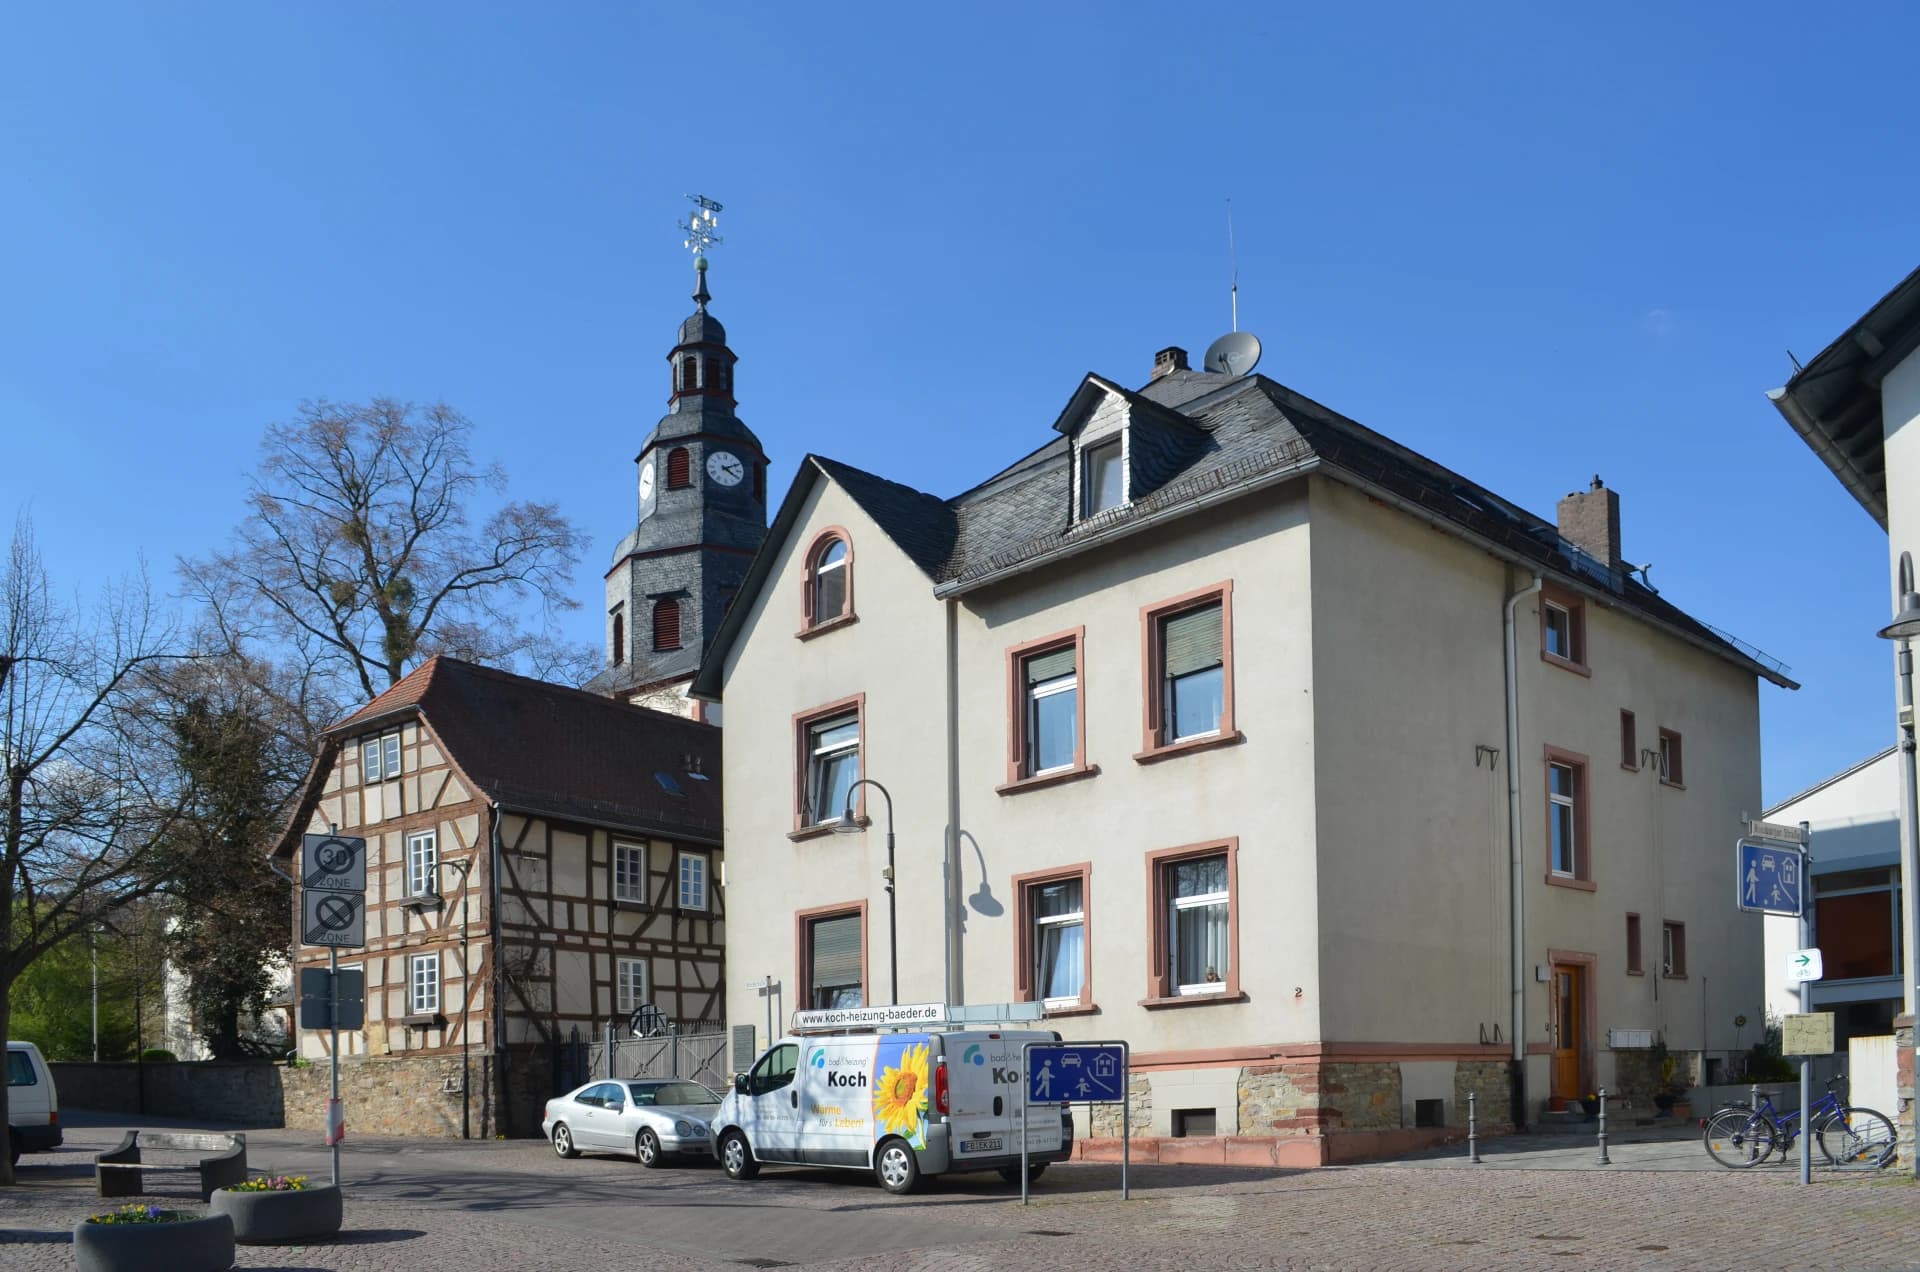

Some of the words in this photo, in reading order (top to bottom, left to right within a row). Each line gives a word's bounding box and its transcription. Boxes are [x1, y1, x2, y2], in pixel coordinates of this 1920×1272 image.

[323, 848, 347, 866] 30
[319, 876, 351, 888] ZONE
[320, 932, 351, 943] ZONE
[802, 1007, 937, 1024] www.koch-heizung-baeder.de
[828, 1071, 867, 1087] Koch
[992, 1067, 1030, 1084] Ko
